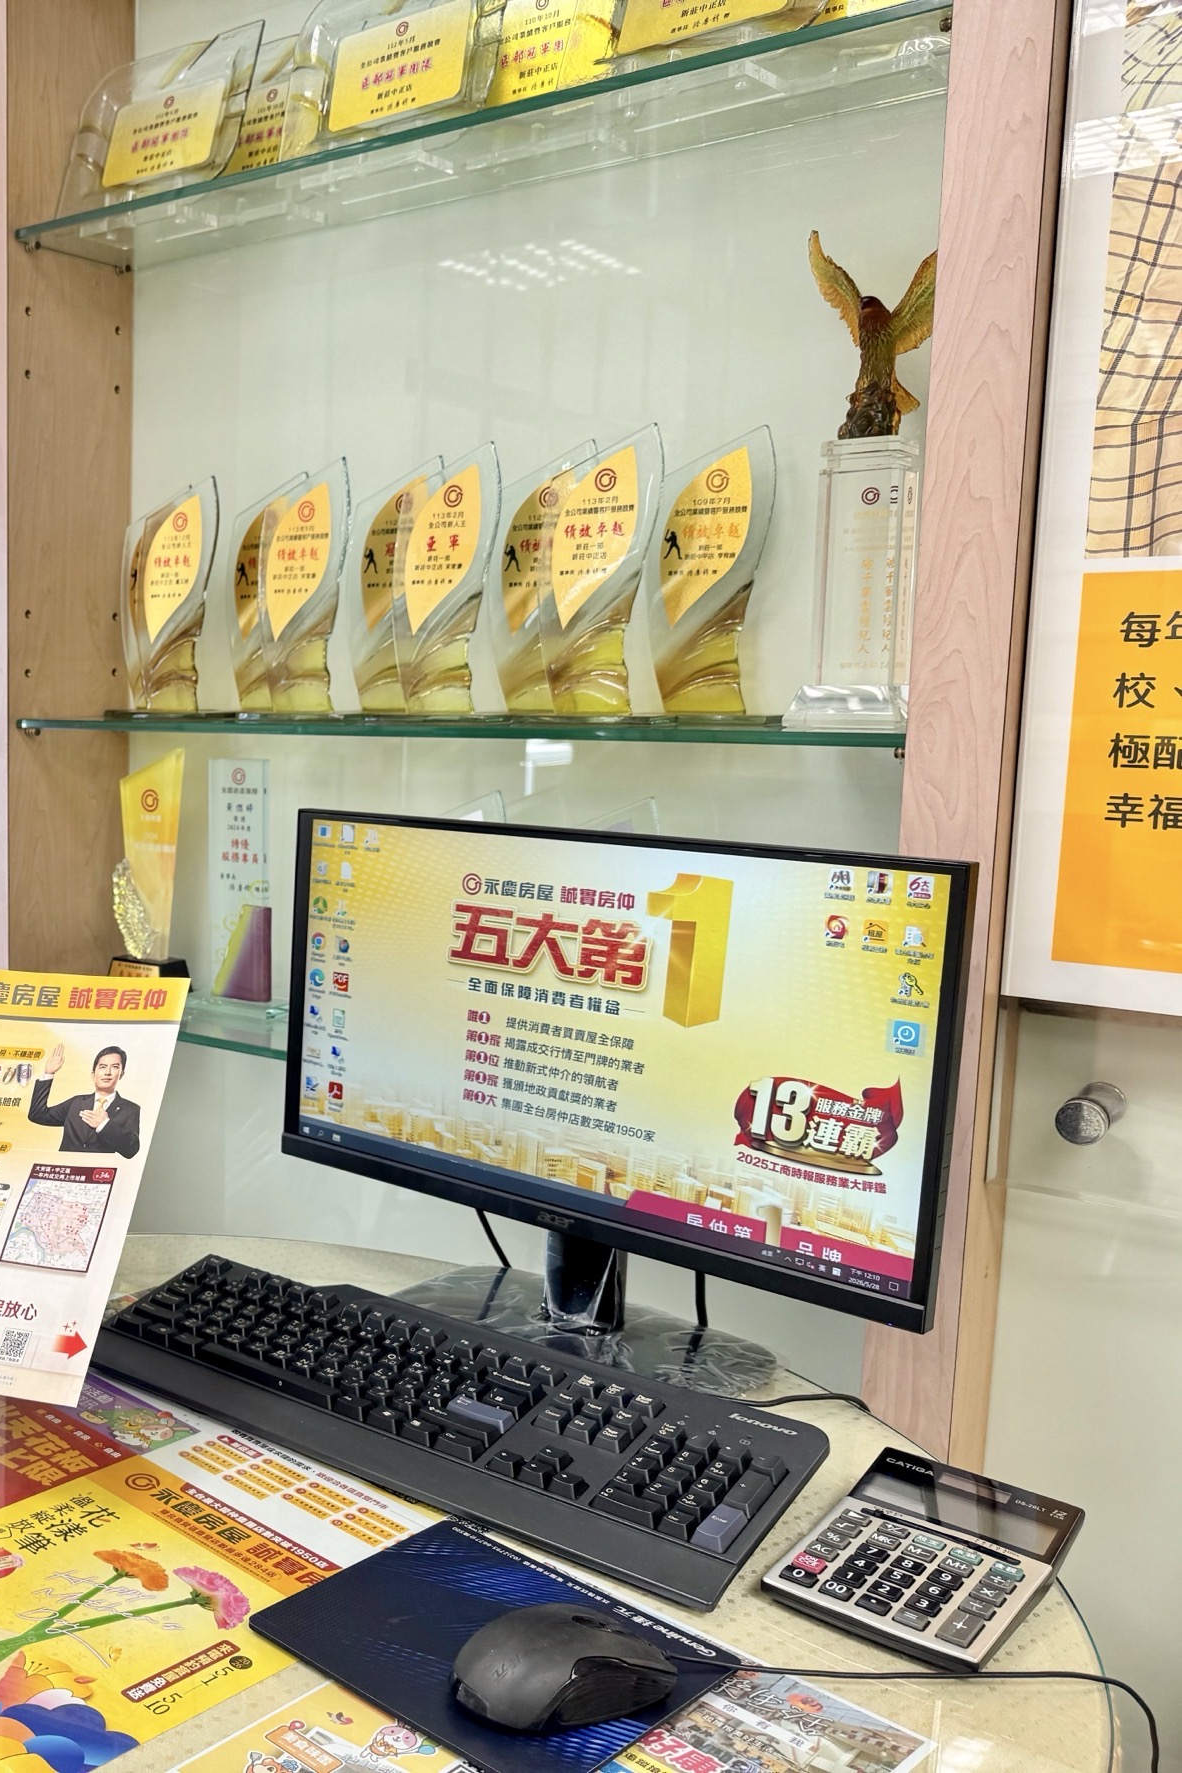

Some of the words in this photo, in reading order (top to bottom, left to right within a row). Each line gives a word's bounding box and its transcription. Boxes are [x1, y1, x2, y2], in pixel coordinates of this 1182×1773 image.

[564, 521, 625, 540] 績效卓越
[484, 878, 554, 902] 永慶房屋
[559, 884, 636, 910] 誠實房仲
[449, 902, 650, 989] 五大第
[333, 972, 348, 983] PDF
[68, 986, 168, 1011] 誠實房仲
[468, 976, 621, 1016] 全面保障消費者權益
[506, 1016, 635, 1051] 提供消費者買賣屋全保障
[503, 1056, 620, 1092] 推動新式仲介的領航者
[504, 1036, 646, 1076] 揭露成交行情至門牌的業者
[502, 1076, 618, 1113] 獲頒地政貢獻獎的業者
[747, 1076, 811, 1146] 13
[814, 1097, 883, 1124] 服務金牌
[501, 1095, 657, 1144] 集團全台房仲店數突破1950家
[803, 1117, 882, 1160] 連霸
[736, 1151, 888, 1196] 2025工商時報服務業大評鑑
[727, 1412, 799, 1437] lenovo
[150, 1487, 252, 1545] 永慶房屋
[811, 1542, 834, 1554] AC
[871, 1533, 897, 1545] MRC
